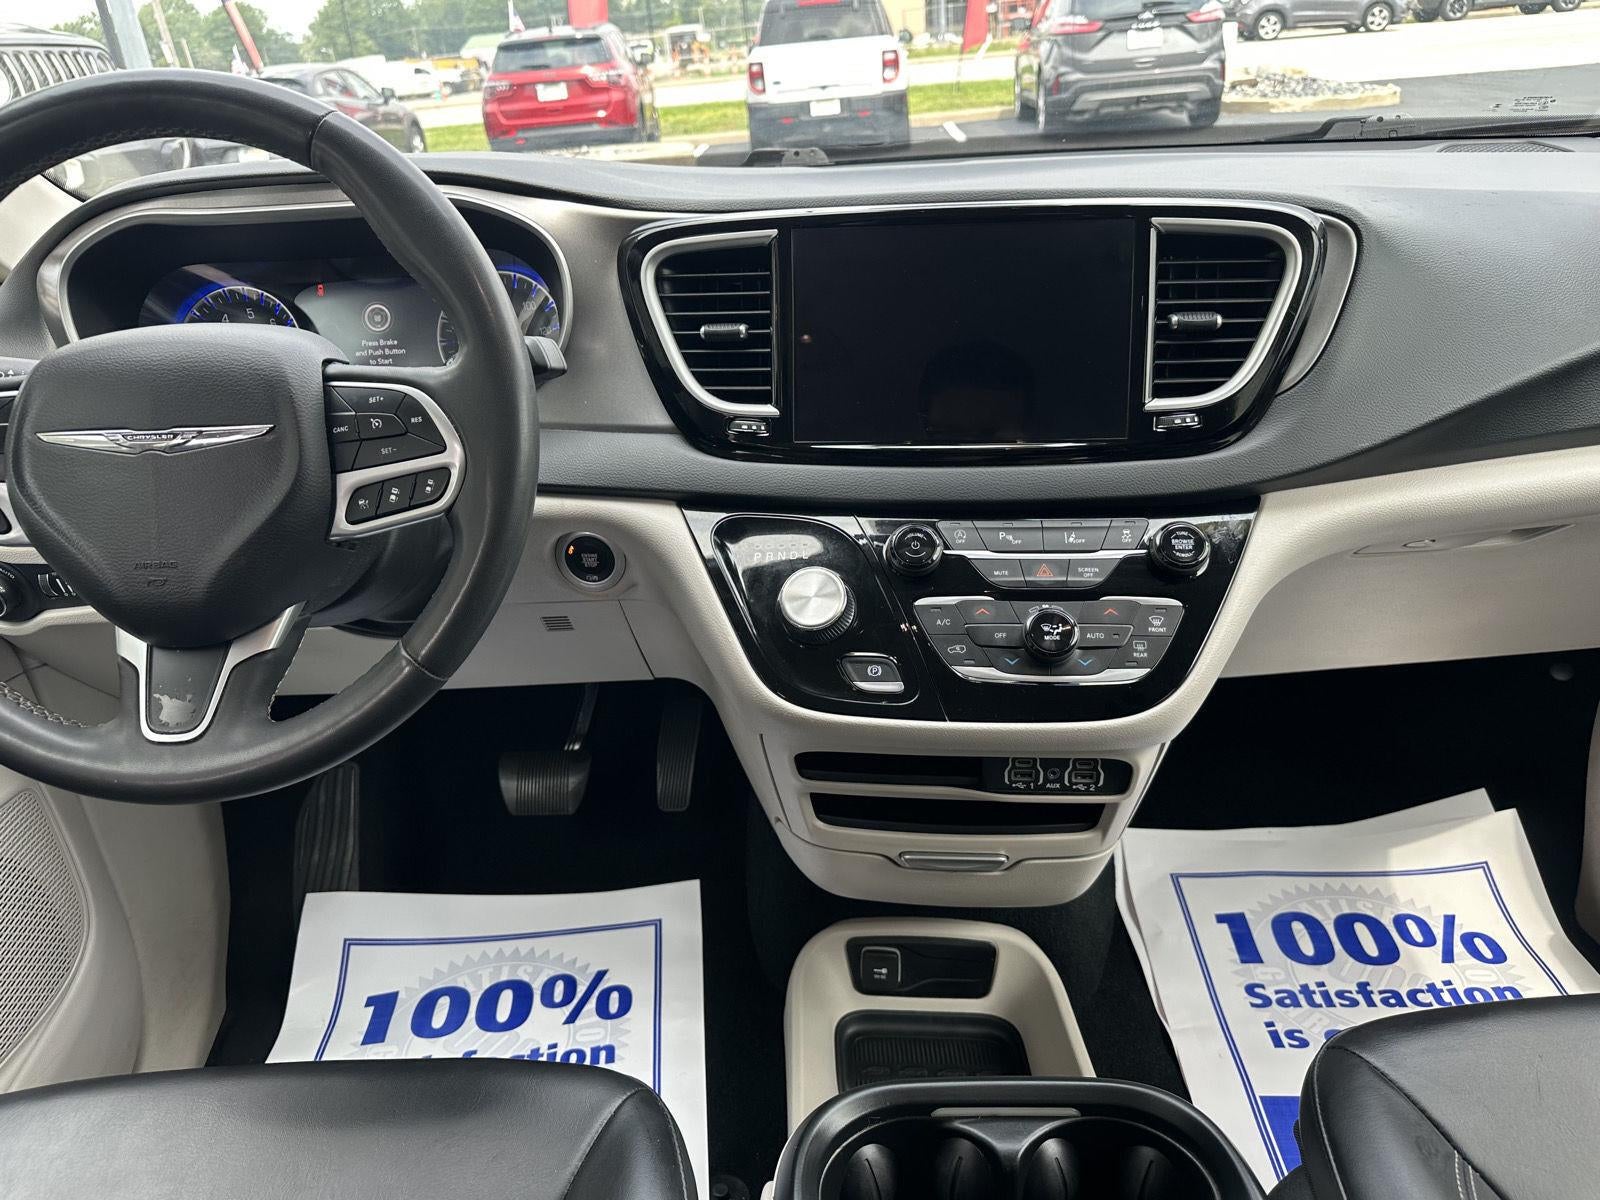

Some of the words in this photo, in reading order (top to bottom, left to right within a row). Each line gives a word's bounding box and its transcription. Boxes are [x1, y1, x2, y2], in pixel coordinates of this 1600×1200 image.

[221, 313, 230, 323] 4
[246, 308, 255, 319] 5
[368, 348, 383, 356] Push
[384, 347, 406, 355] Button
[378, 357, 393, 365] Start
[332, 425, 349, 433] CANC
[1214, 911, 1508, 967] 100%
[1243, 979, 1523, 1009] Satisfaction
[360, 968, 633, 1046] 100%
[1263, 1020, 1310, 1050] is
